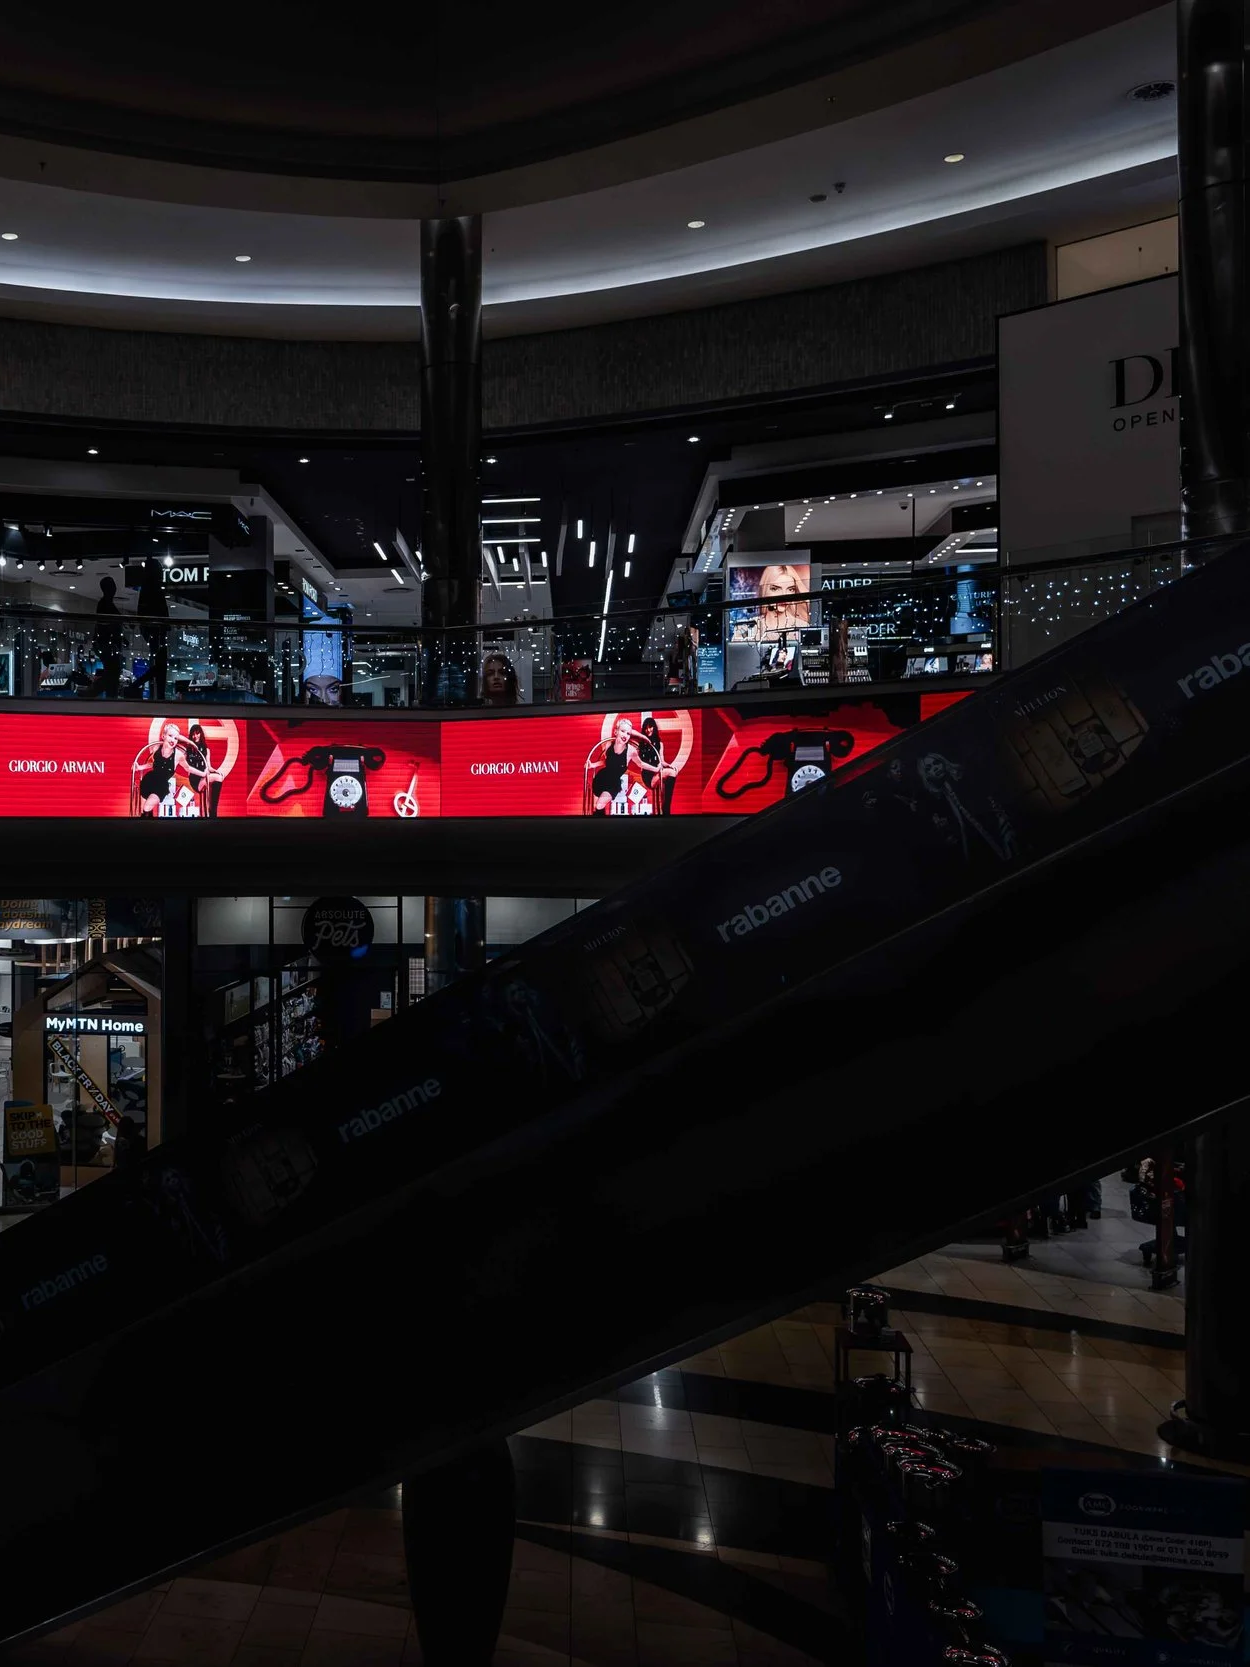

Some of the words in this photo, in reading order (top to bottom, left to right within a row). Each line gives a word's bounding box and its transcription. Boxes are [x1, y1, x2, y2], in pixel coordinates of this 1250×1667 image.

[1108, 347, 1181, 409] DI
[162, 566, 199, 583] TOM
[821, 578, 873, 591] AUDER
[8, 759, 58, 773] GIORGIO
[61, 760, 105, 774] ARMANI
[470, 762, 515, 775] GIORGIO
[518, 760, 559, 774] ARMANI
[716, 865, 843, 945] rabanne
[314, 909, 366, 920] ABSOLUTE
[312, 920, 367, 950] Pets
[46, 1017, 99, 1032] MyMTN
[101, 1019, 144, 1033] Home
[337, 1076, 443, 1145] rabanne
[20, 1252, 110, 1312] rabanne
